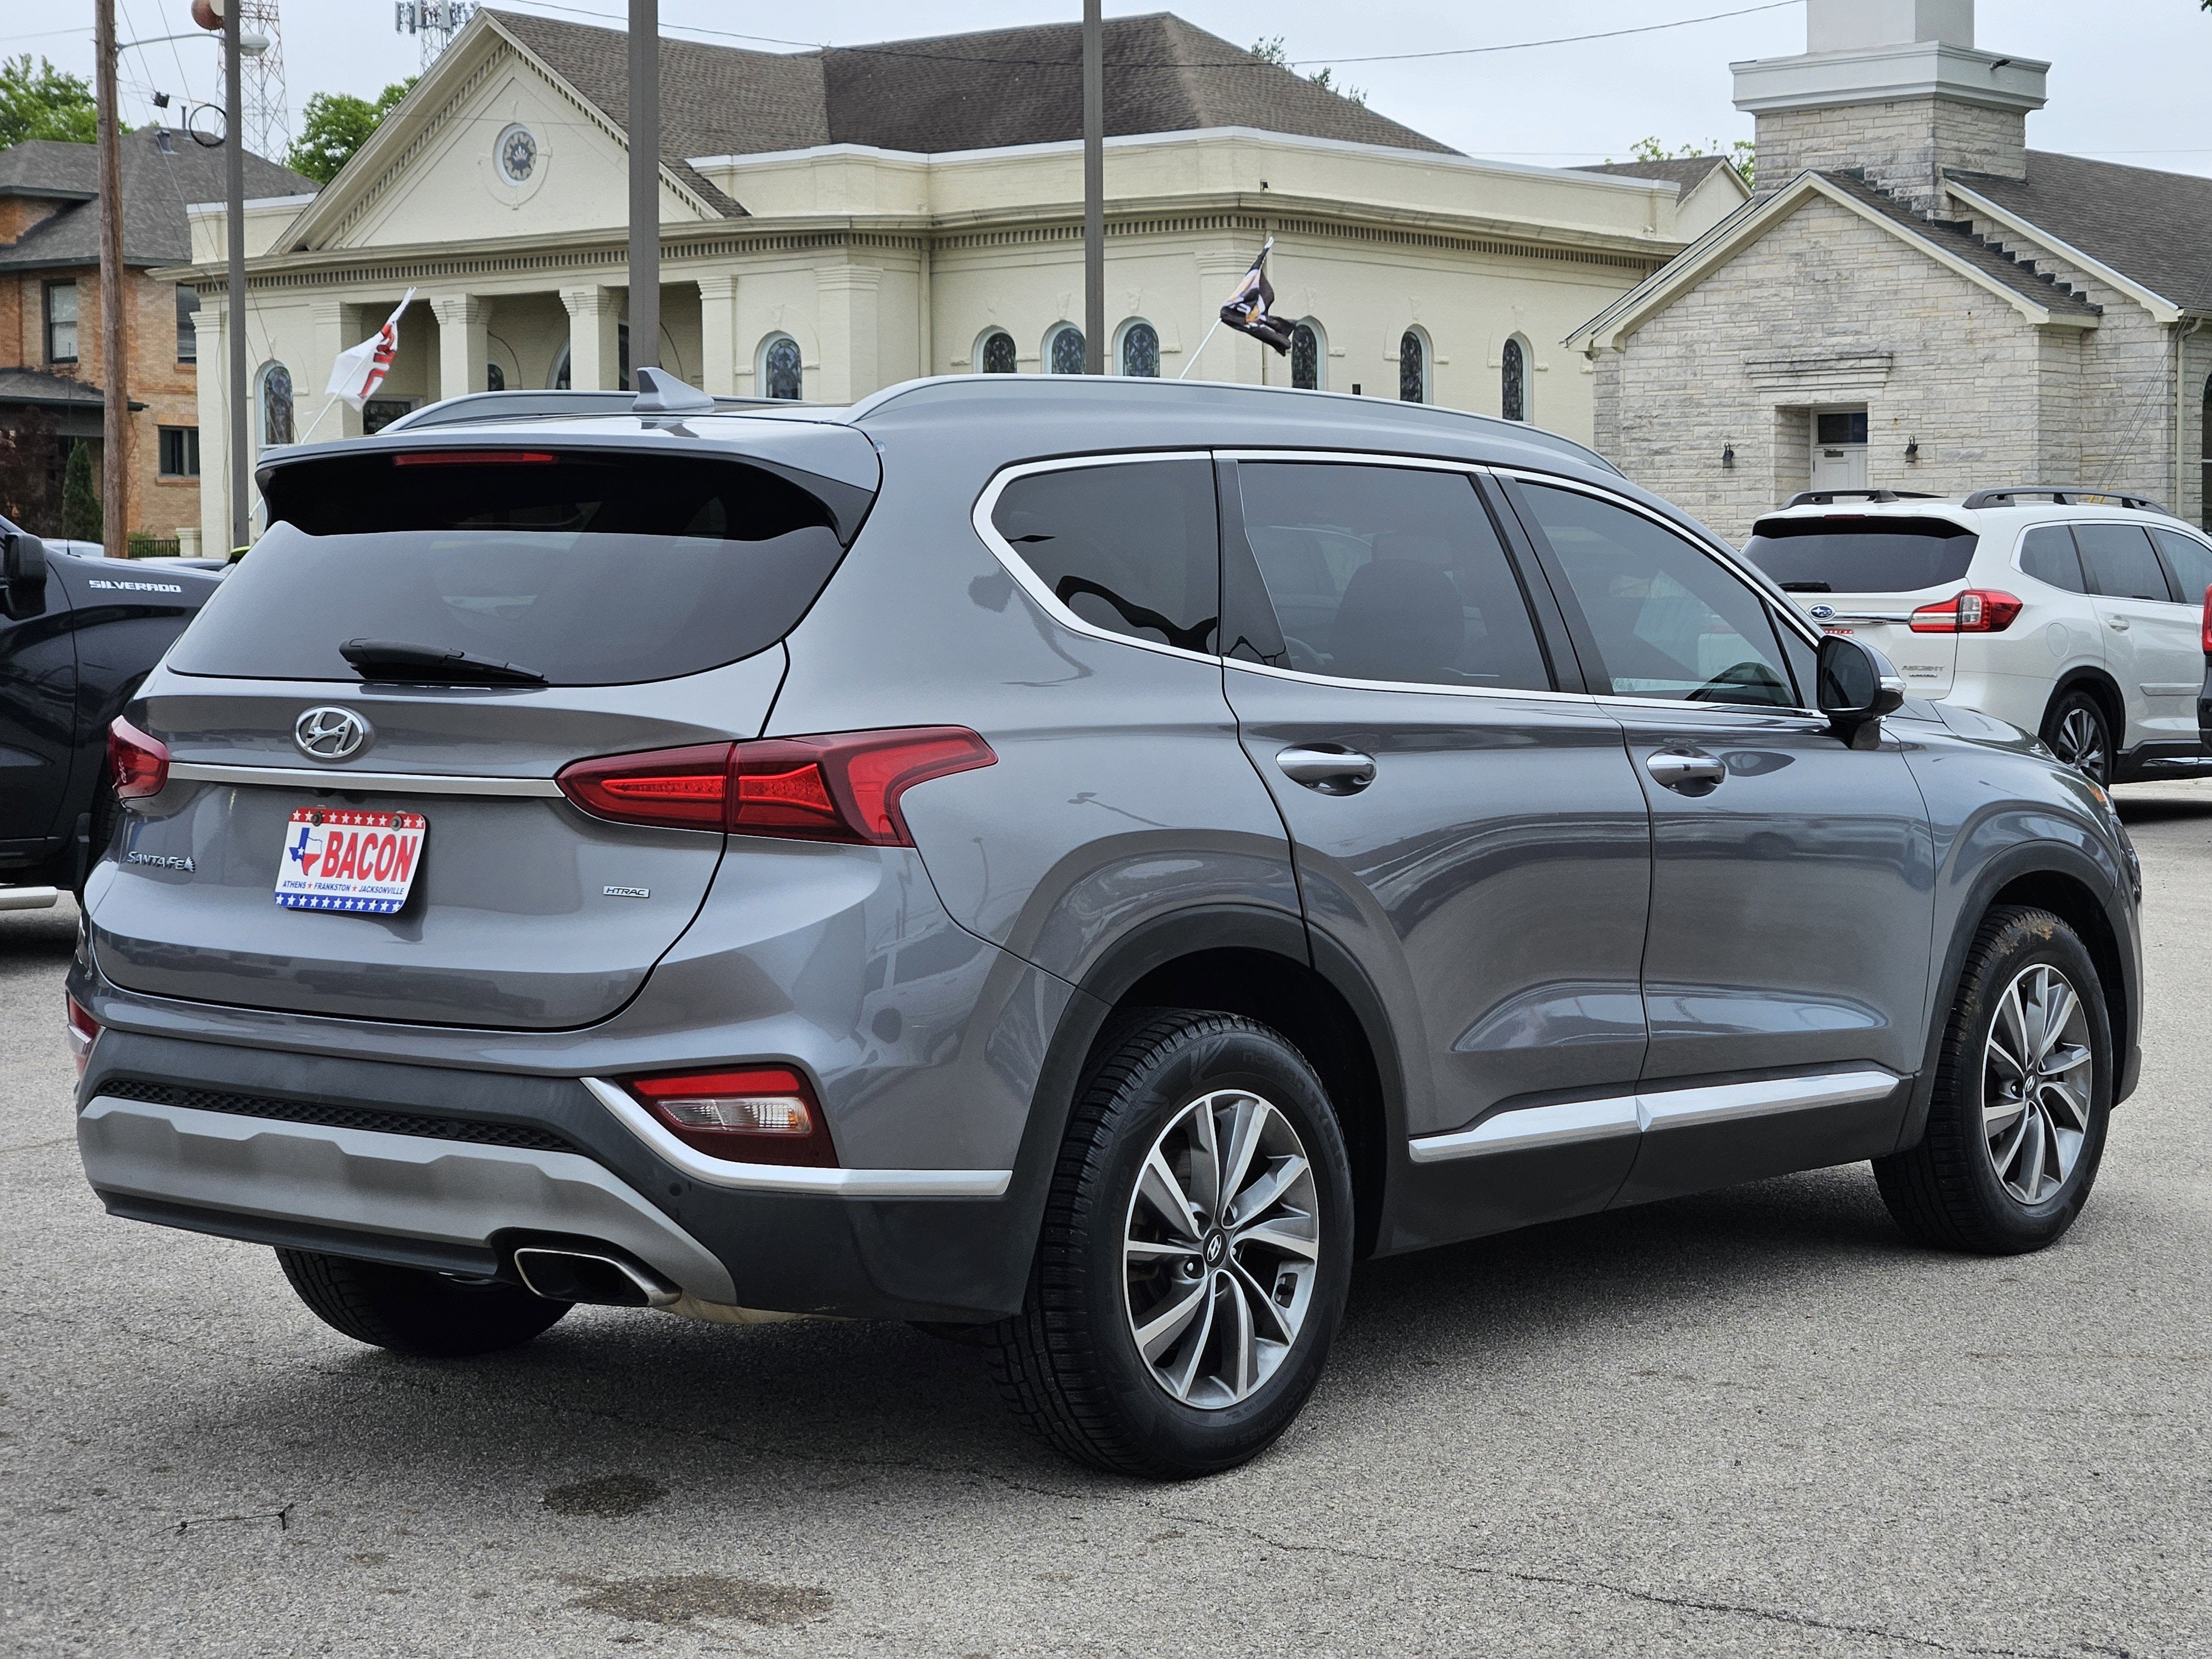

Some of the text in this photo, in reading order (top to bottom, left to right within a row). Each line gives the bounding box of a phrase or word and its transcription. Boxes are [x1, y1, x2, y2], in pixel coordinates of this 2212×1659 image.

[89, 580, 181, 592] SILVERADO
[127, 851, 165, 868] SANTA
[320, 831, 418, 882] BACON
[282, 880, 405, 895] ATHENS FRANKSTON JACKSONVILLE
[606, 887, 645, 896] HTRAC
